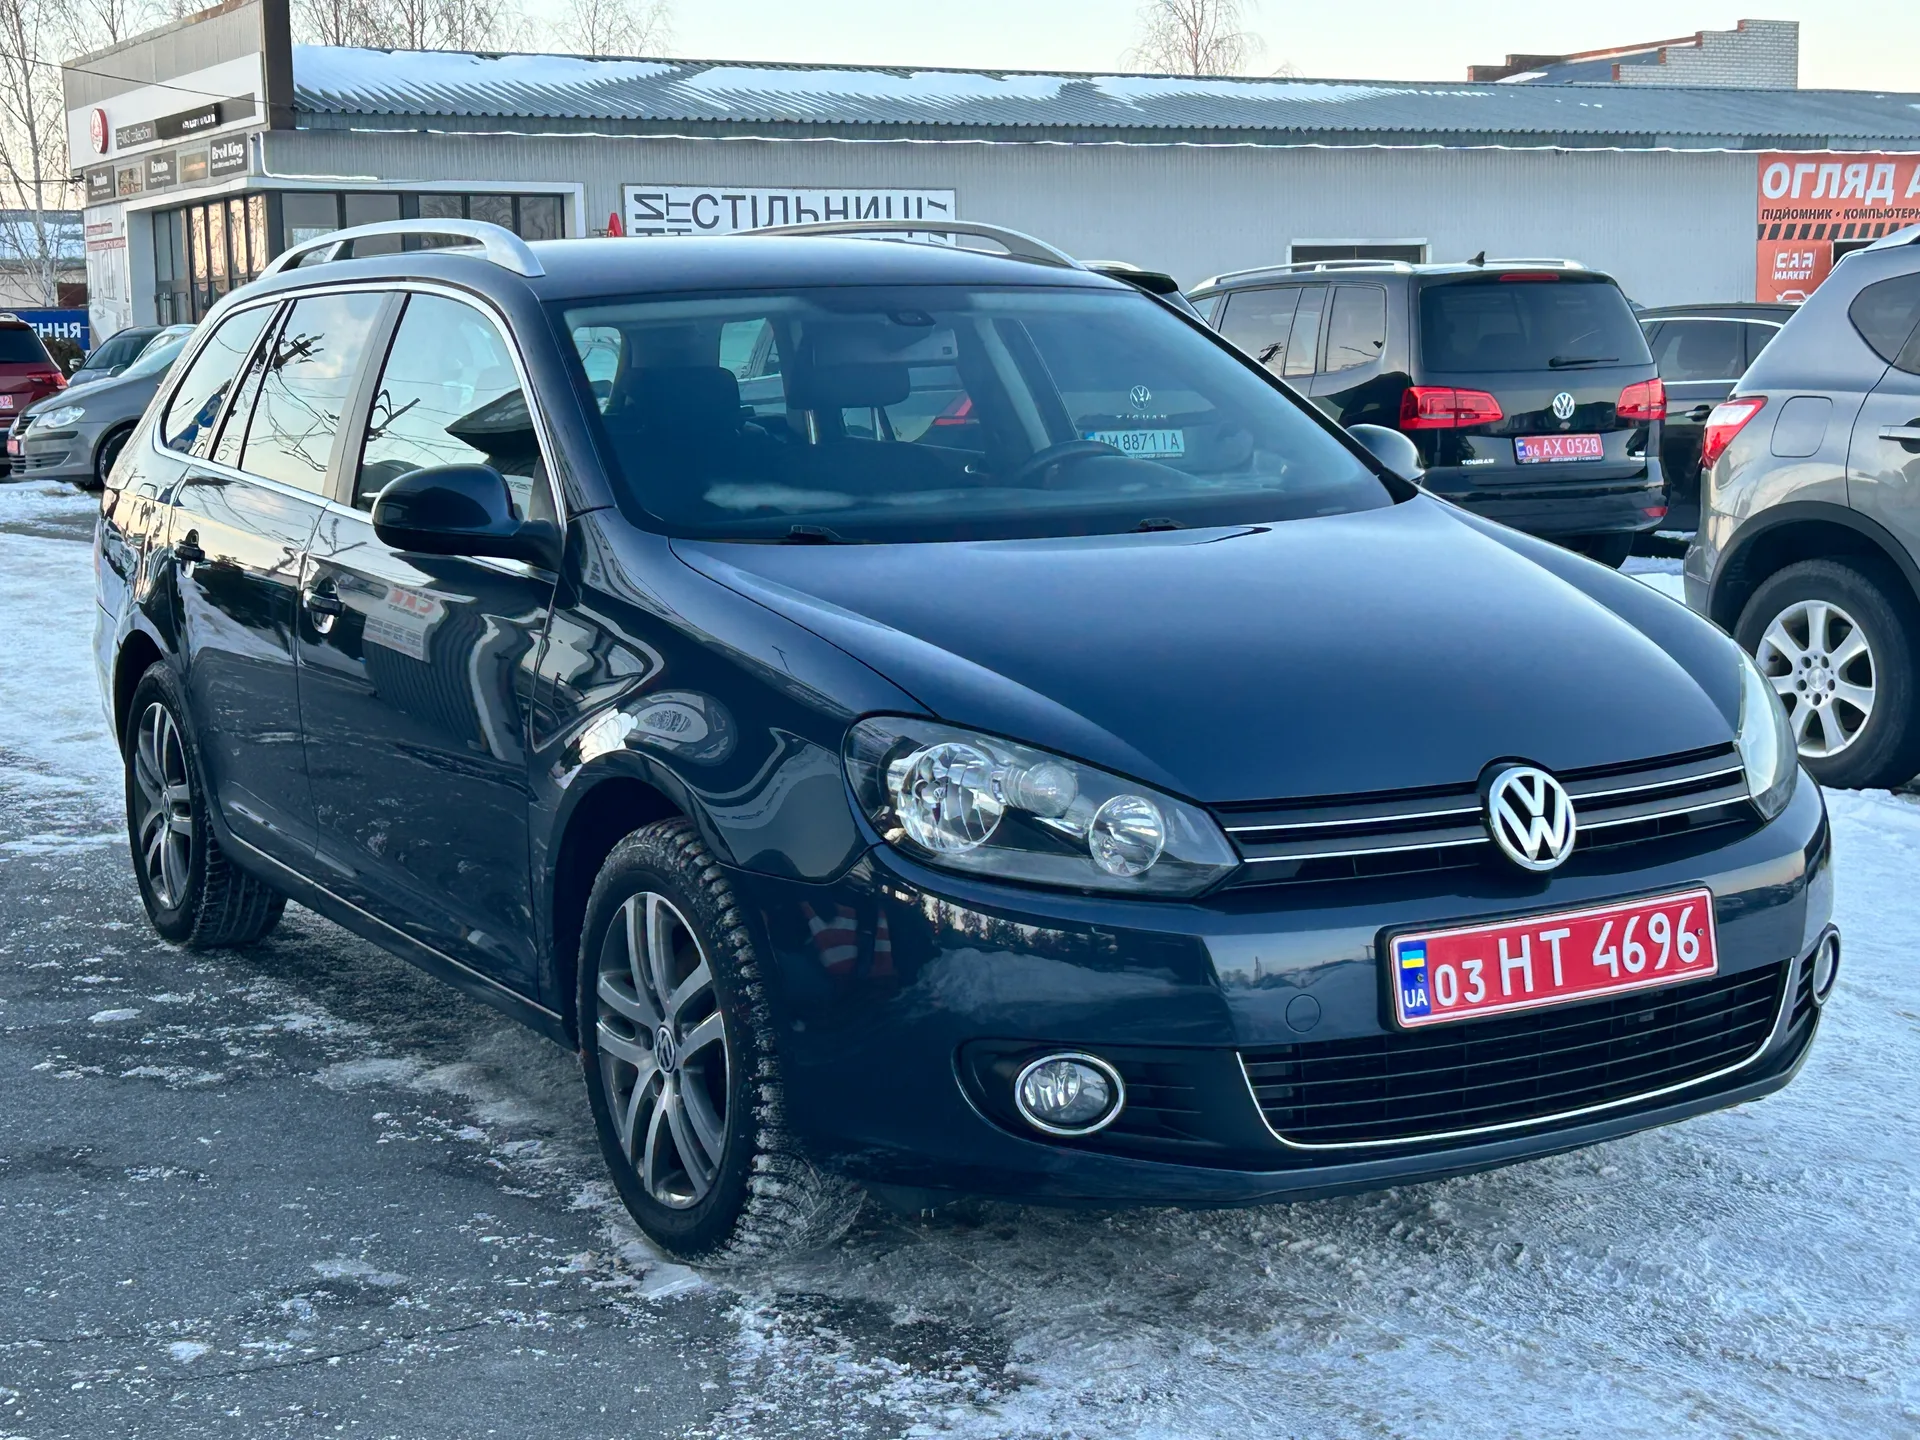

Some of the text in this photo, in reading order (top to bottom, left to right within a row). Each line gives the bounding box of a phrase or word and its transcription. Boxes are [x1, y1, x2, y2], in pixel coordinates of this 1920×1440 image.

[1762, 162, 1896, 206] ОГЛЯД
[1761, 206, 1833, 221] ПІДЙОМНИК
[1774, 271, 1811, 280] MARKET
[1123, 433, 1157, 451] 8871
[1526, 438, 1598, 456] 06 AX 0528
[1489, 766, 1576, 871] VW
[1434, 905, 1701, 1007] 03 HT 4696
[1405, 988, 1428, 1008] UA
